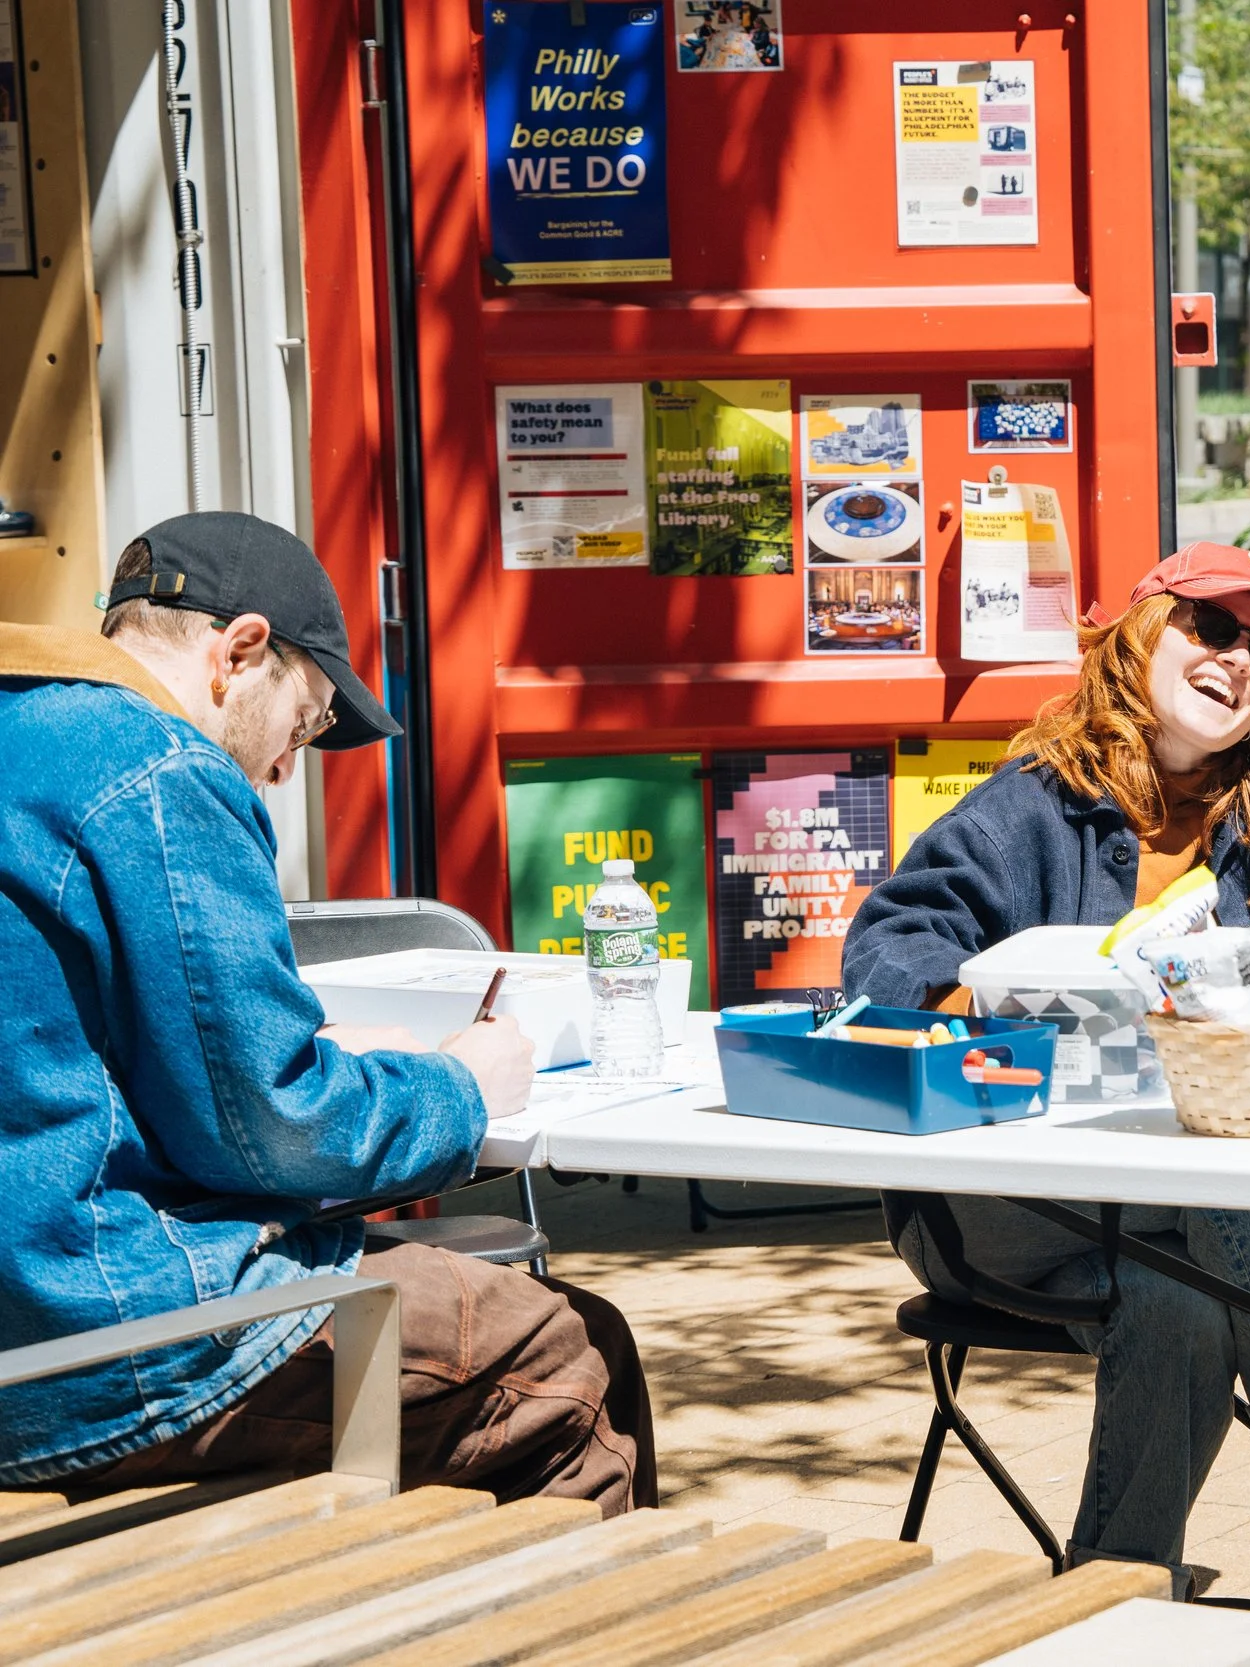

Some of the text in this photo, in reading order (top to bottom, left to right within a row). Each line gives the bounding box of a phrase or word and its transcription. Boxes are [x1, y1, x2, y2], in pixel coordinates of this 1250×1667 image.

[535, 48, 619, 79] Philly
[531, 86, 625, 112] Works
[510, 123, 644, 149] because
[507, 153, 647, 191] WE DO
[539, 231, 572, 239] Common
[510, 402, 592, 414] What does
[510, 417, 603, 430] safety mean
[510, 431, 565, 445] to you?
[656, 446, 739, 461] Fund full
[657, 468, 735, 486] staffing
[658, 491, 760, 504] at the Free
[658, 511, 735, 528] Library.
[924, 782, 960, 795] WAKE
[765, 807, 839, 830] $1.8M
[564, 829, 653, 865] FUND
[755, 829, 851, 850] FOR PA
[722, 850, 884, 874] IMMIGRANT
[754, 872, 855, 895] FAMILY
[762, 895, 846, 917] UNITY
[743, 916, 853, 940] PROJEC
[602, 932, 640, 950] Poland
[605, 944, 642, 964] Spring
